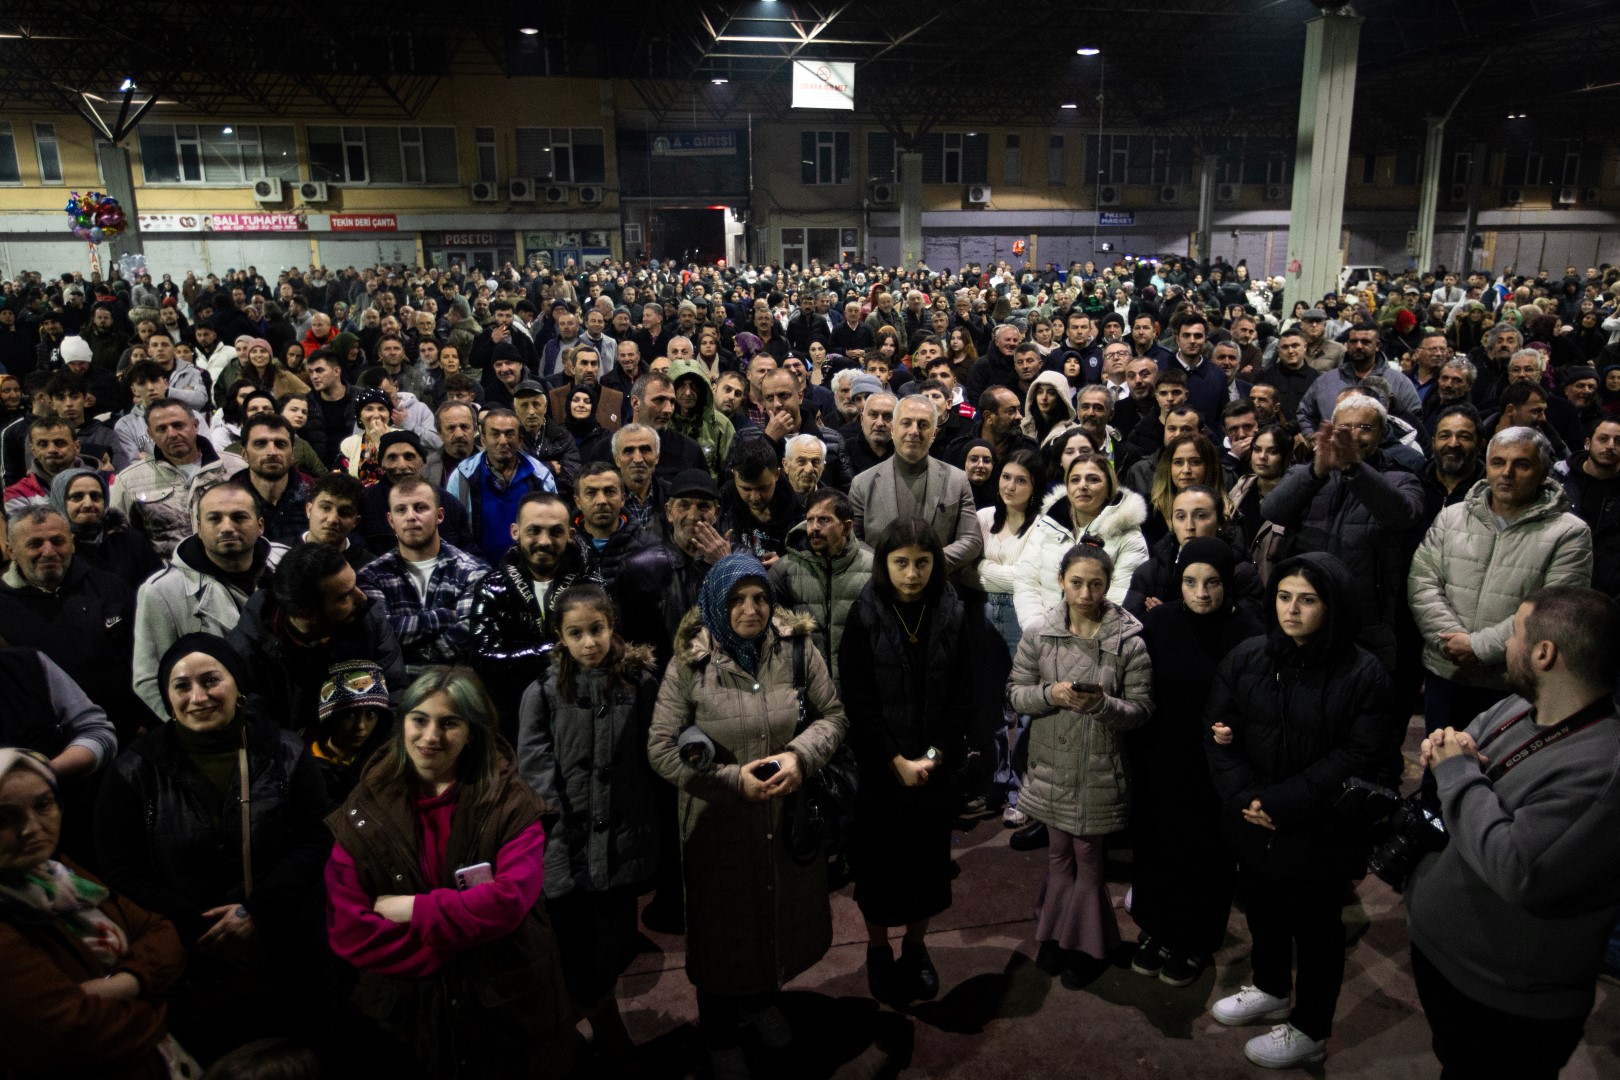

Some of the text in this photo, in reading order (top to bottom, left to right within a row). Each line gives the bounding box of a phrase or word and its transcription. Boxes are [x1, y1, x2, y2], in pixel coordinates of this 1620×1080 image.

[241, 214, 297, 226] TUHAFİYE
[332, 217, 396, 228] TEKİN DERİ ÇANTA
[506, 564, 535, 604] MONCLER
[1505, 749, 1529, 767] EOS
[1530, 740, 1544, 751] 5D
